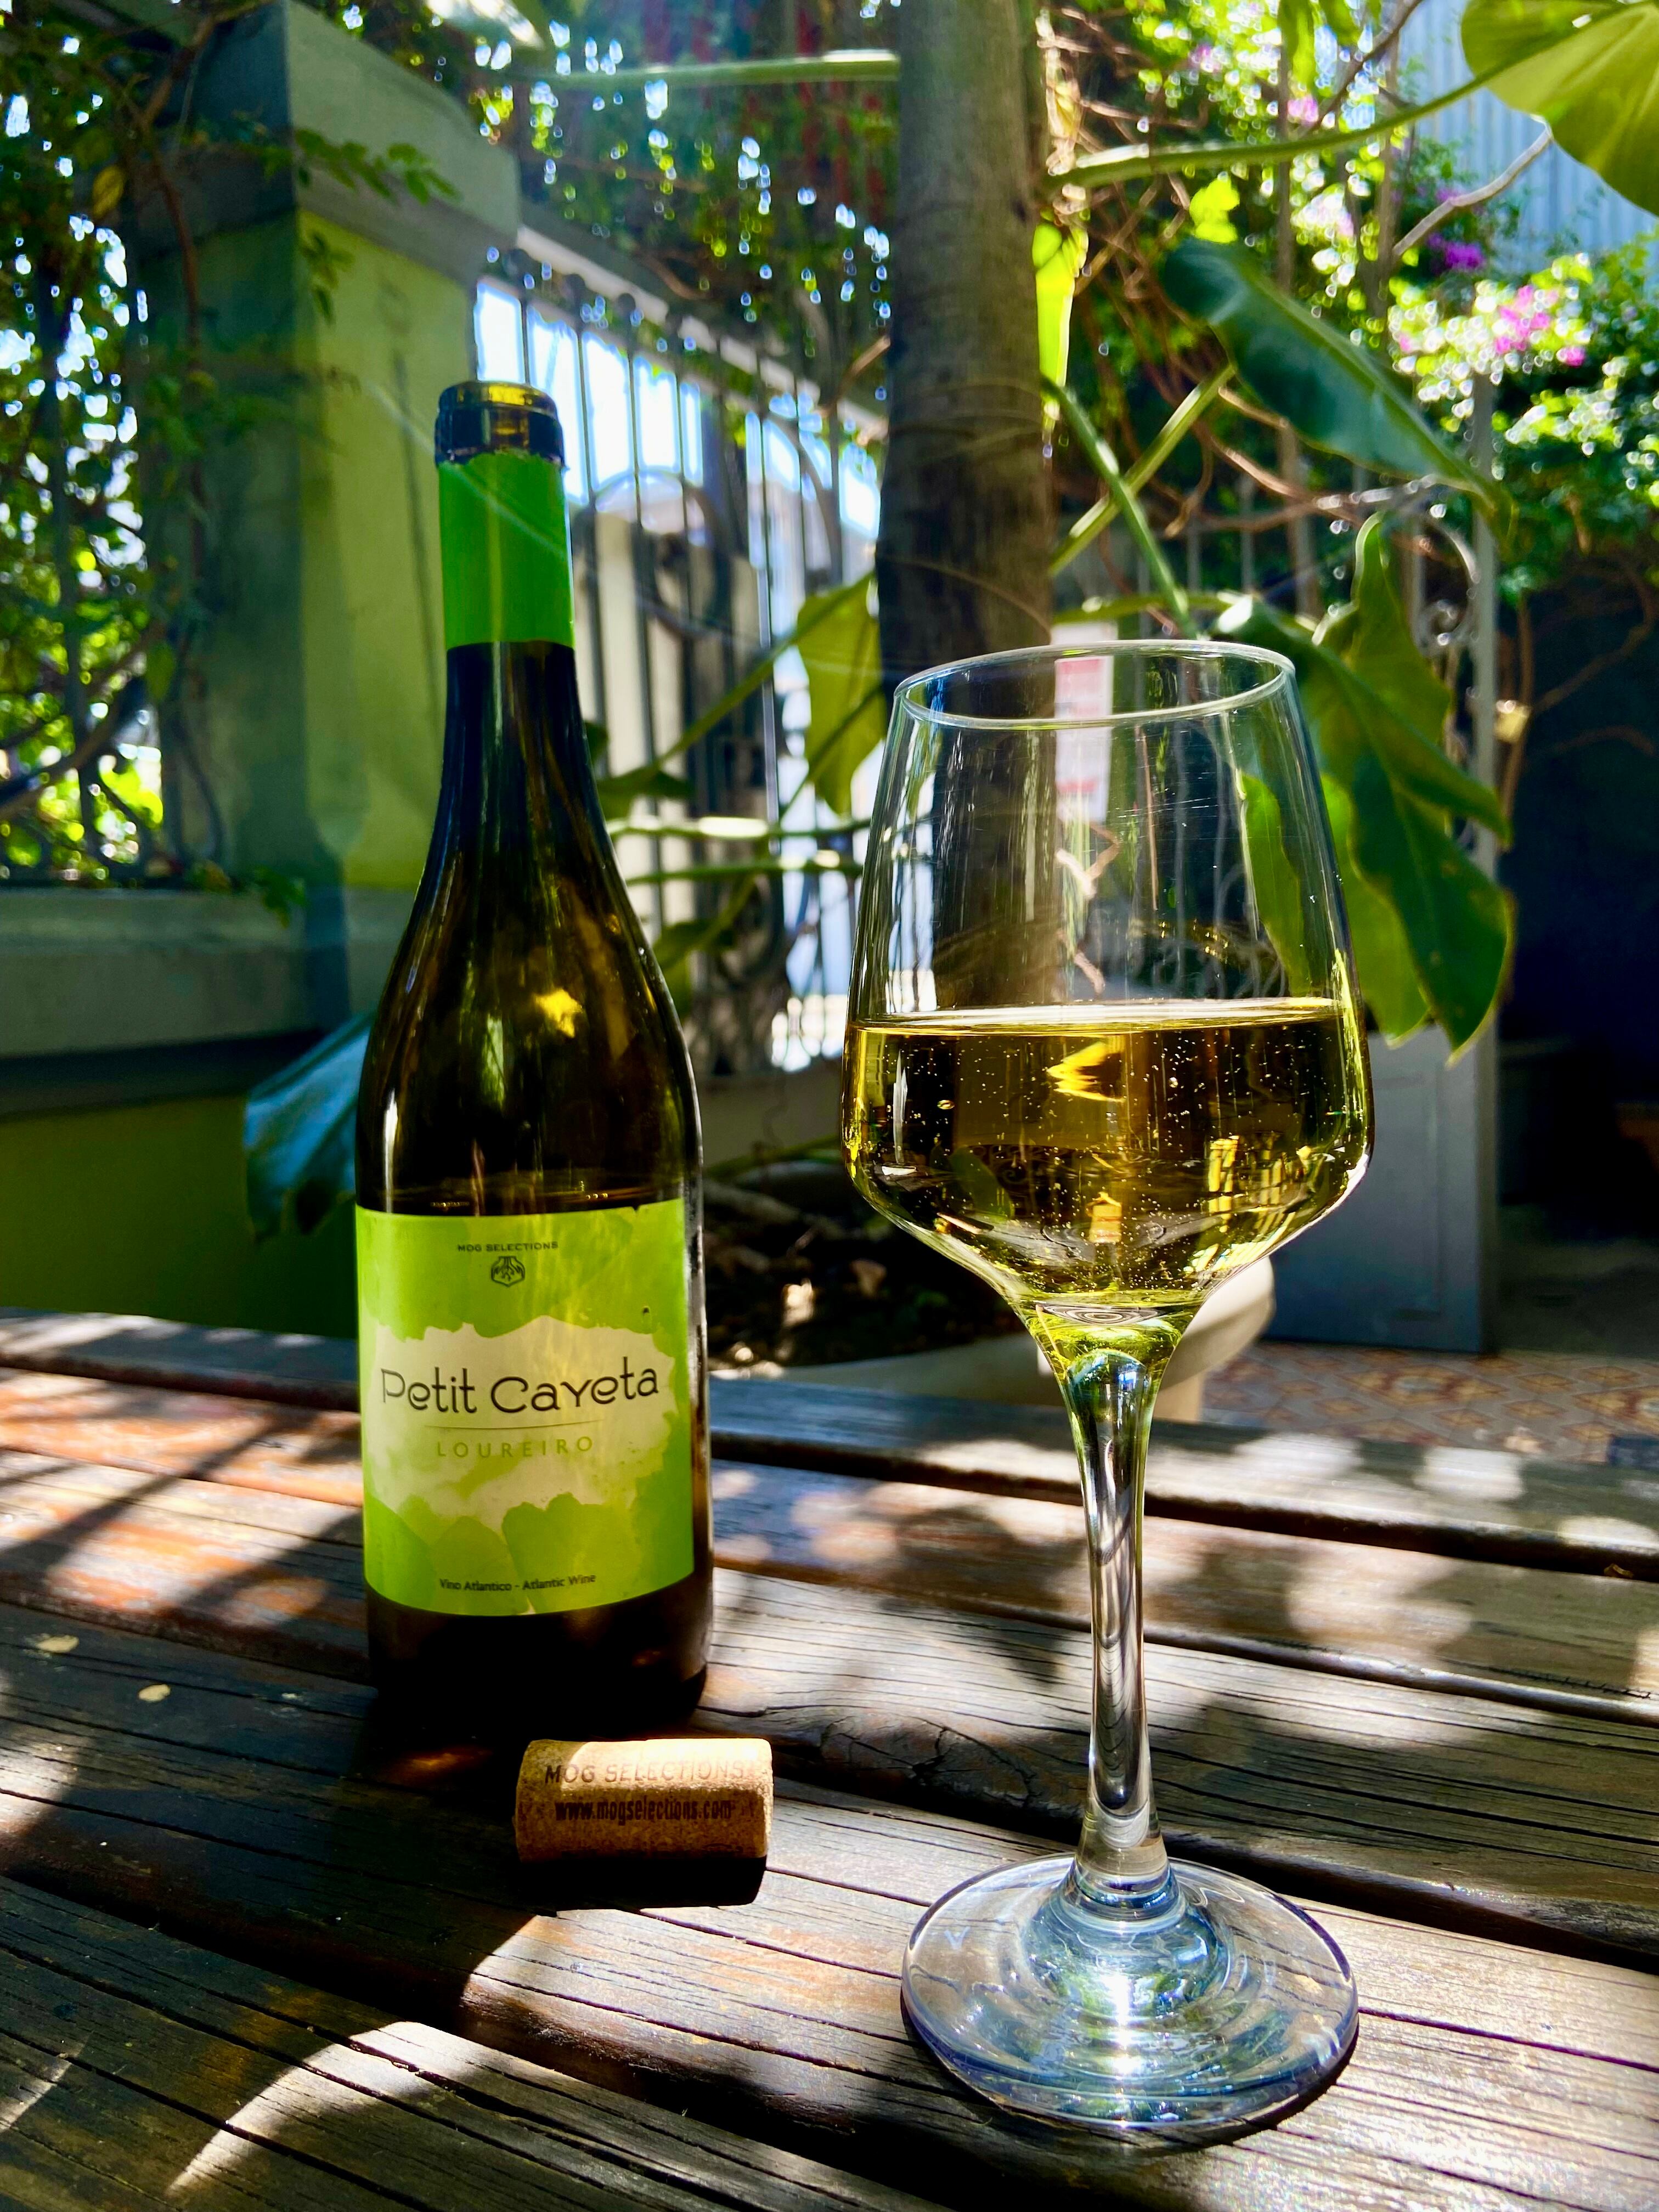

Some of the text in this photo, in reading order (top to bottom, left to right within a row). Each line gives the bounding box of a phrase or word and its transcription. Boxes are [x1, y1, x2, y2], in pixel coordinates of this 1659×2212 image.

[458, 1241, 558, 1252] MOG SELECTIONS
[381, 1367, 477, 1414] Petit
[437, 1436, 593, 1458] LOUREIRO
[439, 1578, 461, 1590] Vino
[522, 1578, 565, 1590] Atlantic
[568, 1574, 596, 1585] Wine
[545, 1759, 744, 1784] MOG SELECTIONS
[555, 1795, 732, 1826] www.mogselections.com
